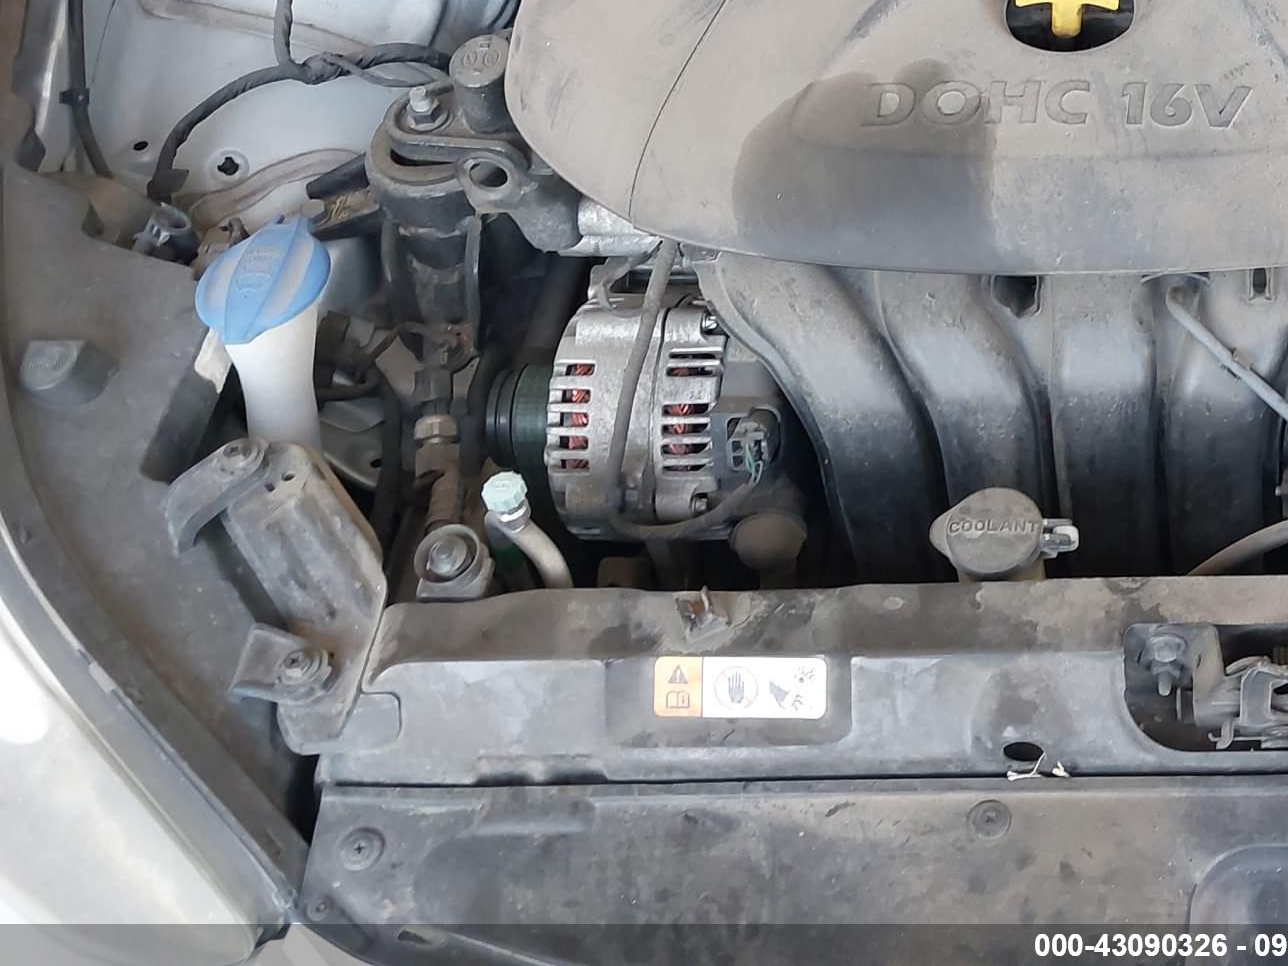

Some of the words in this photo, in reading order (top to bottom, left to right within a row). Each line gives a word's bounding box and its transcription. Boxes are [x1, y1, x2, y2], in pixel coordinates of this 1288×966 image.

[860, 80, 1090, 127] DOHC
[1120, 81, 1254, 129] 16V
[948, 518, 1040, 536] COOLANT
